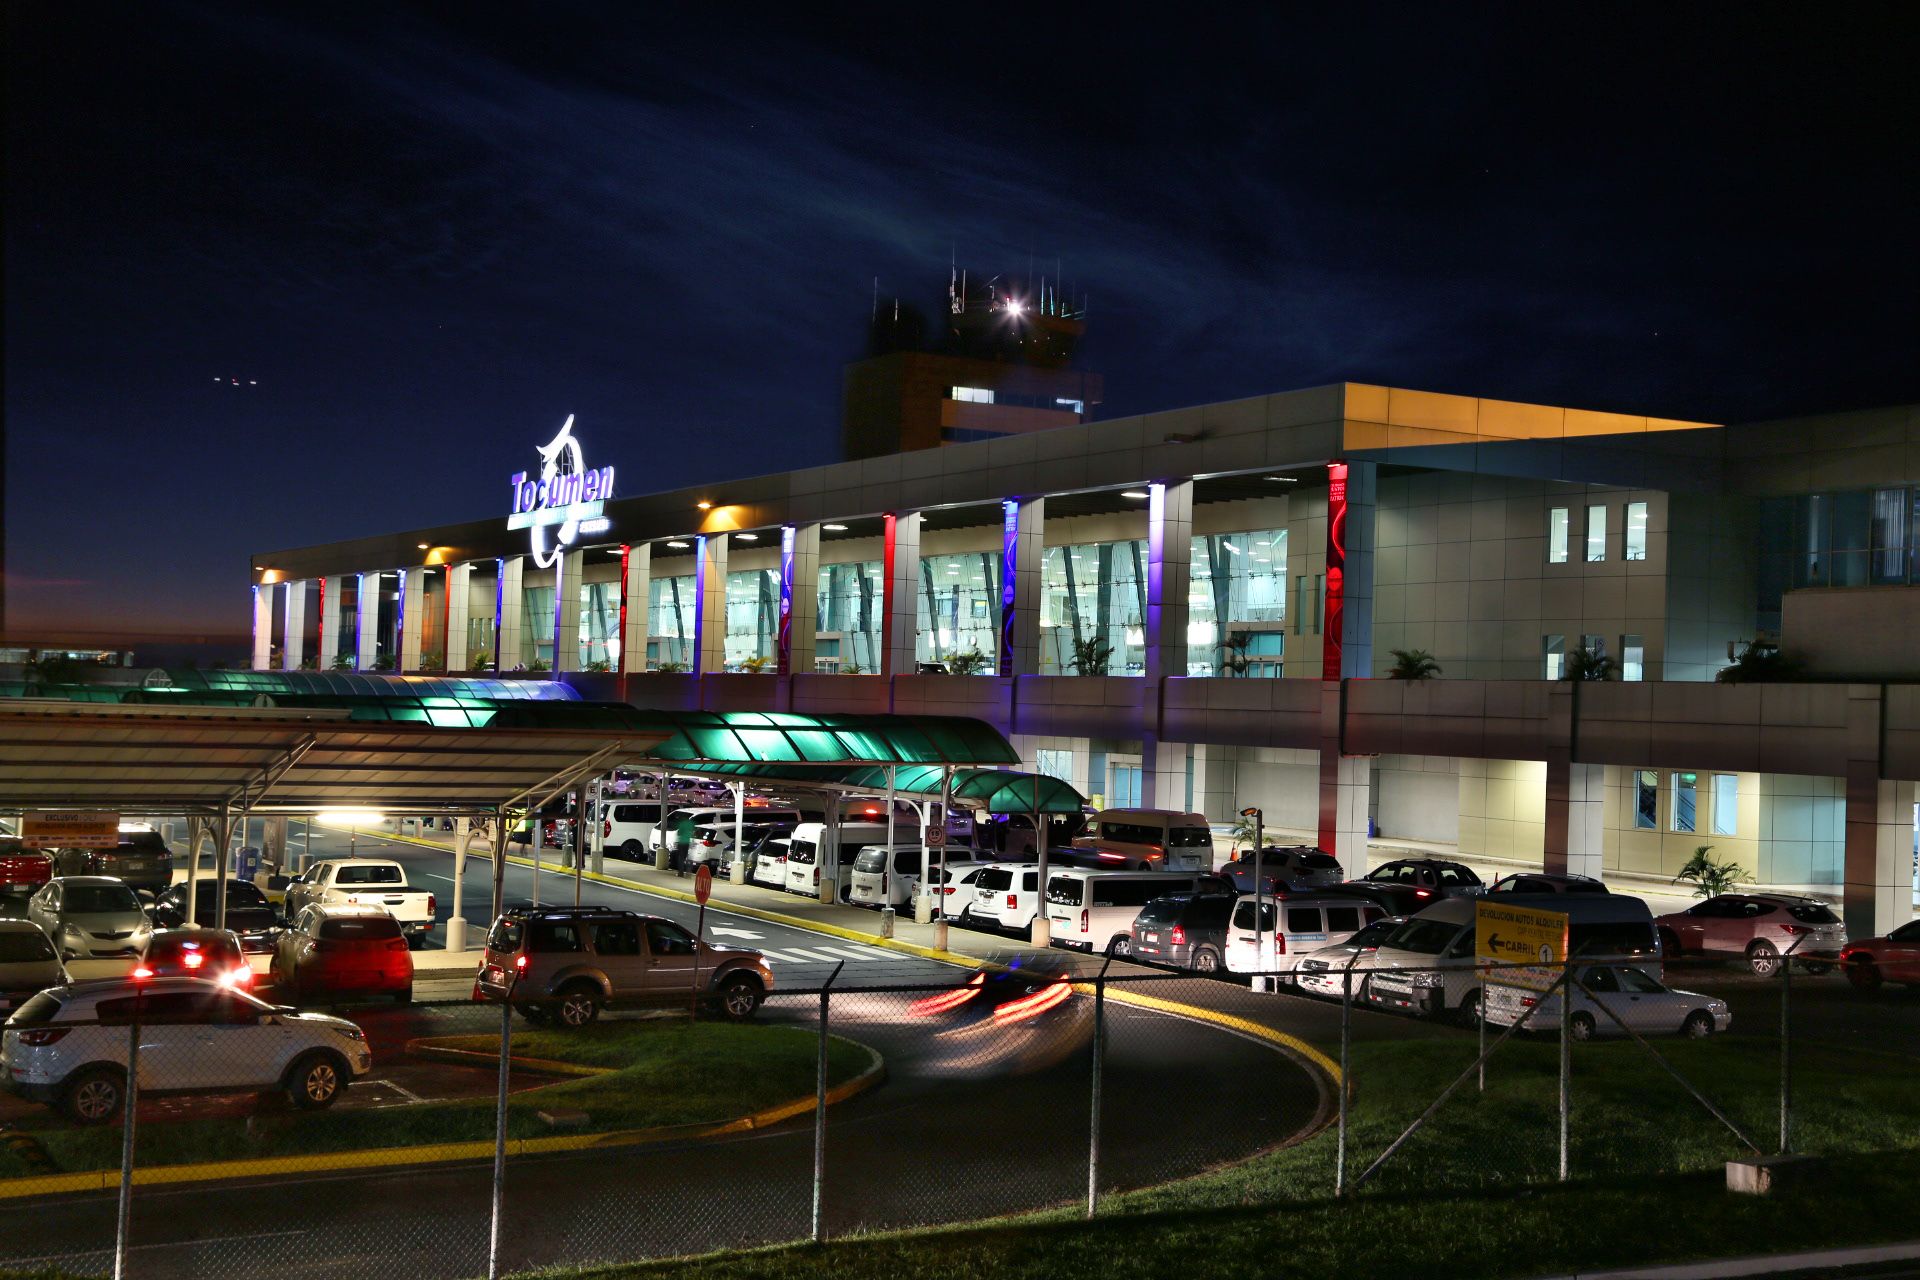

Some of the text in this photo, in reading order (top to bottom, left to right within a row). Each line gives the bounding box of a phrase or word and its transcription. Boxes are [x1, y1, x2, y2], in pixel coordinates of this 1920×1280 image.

[511, 465, 615, 513] Tocumen
[696, 876, 711, 894] ALTO
[1479, 908, 1564, 930] DEVOLUCION AUTOS ALQUILER
[1505, 940, 1548, 962] CARRIL 1
